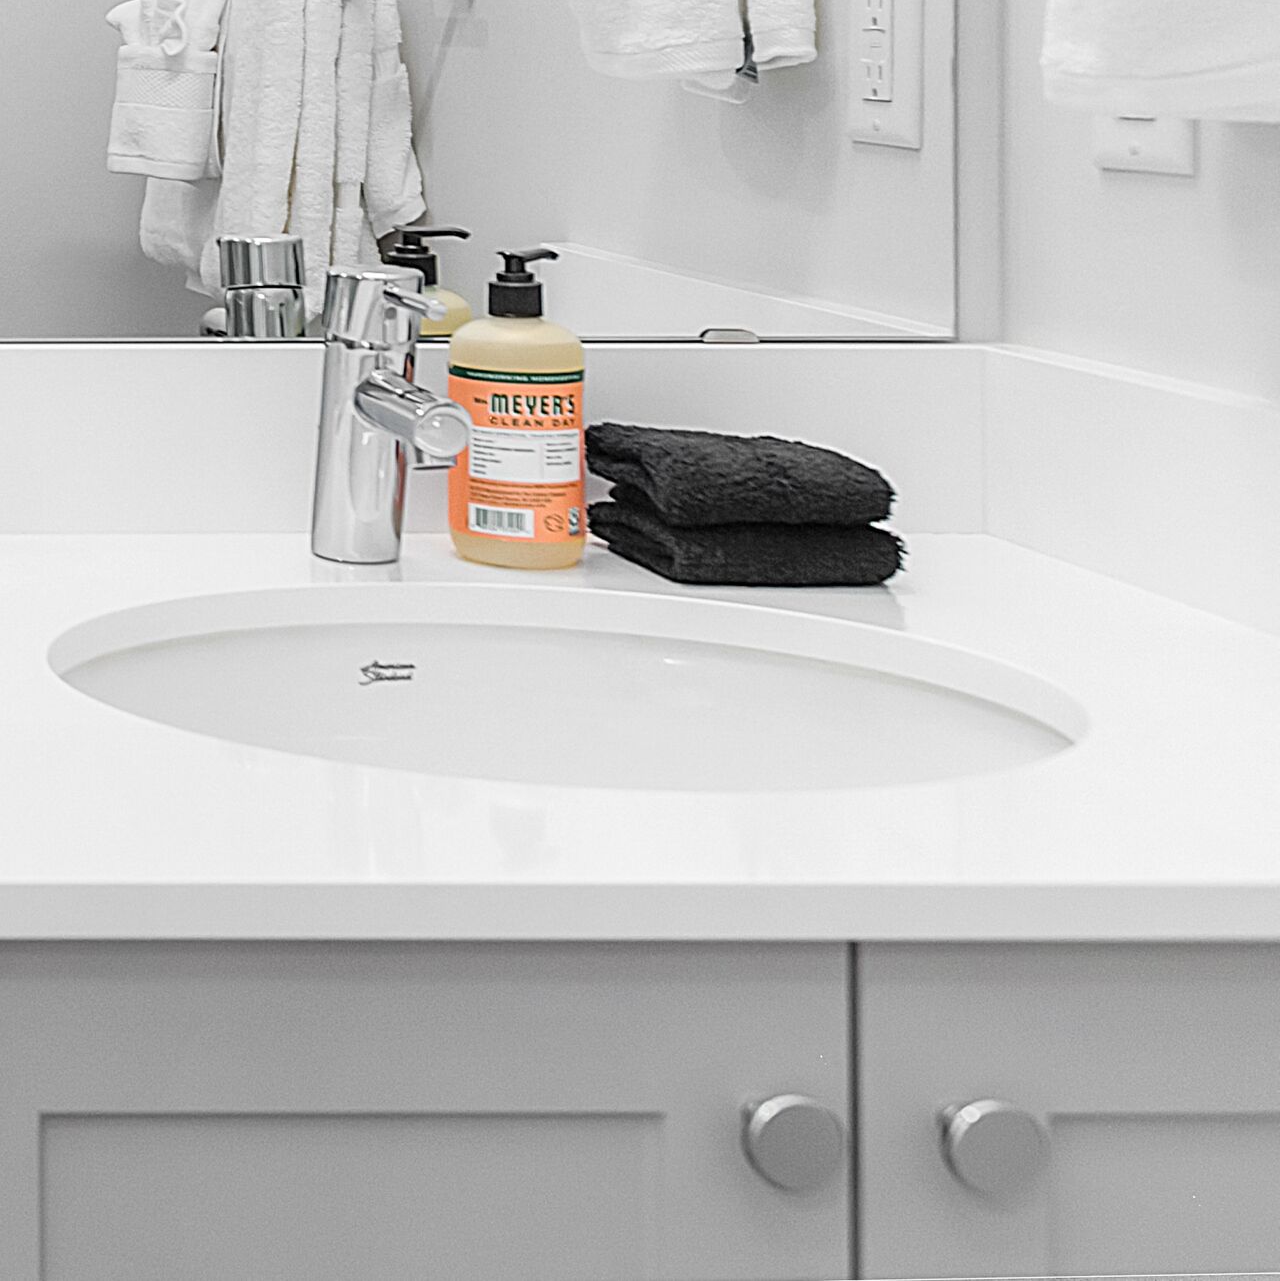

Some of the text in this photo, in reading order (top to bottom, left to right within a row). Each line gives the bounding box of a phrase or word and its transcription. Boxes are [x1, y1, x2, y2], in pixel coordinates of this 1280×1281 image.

[491, 393, 576, 415] MEYER'S
[490, 416, 575, 428] CLEAN DAY
